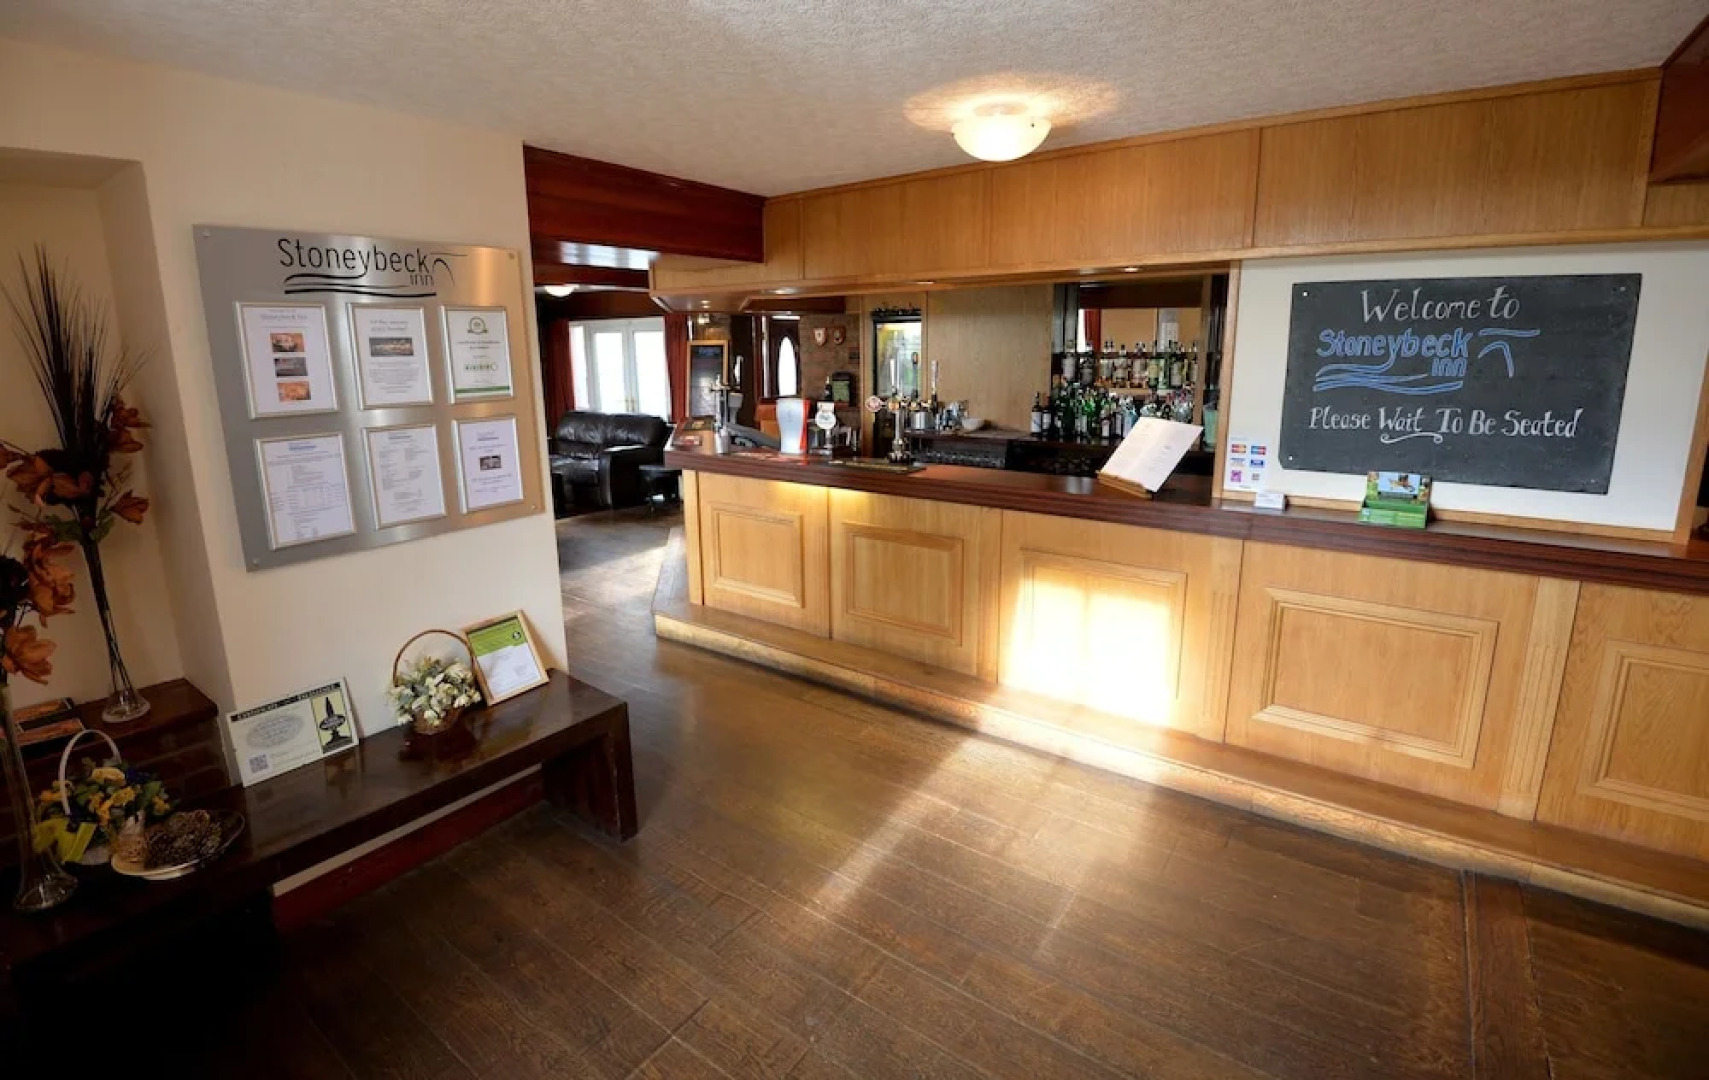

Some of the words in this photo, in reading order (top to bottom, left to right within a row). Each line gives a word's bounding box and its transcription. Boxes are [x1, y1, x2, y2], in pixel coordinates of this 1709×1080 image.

[277, 238, 430, 275] Stoneybeck
[1361, 286, 1481, 323] Welcome
[1487, 285, 1520, 319] to
[1316, 327, 1473, 361] Stoneybeck
[1308, 405, 1372, 430] Please
[1377, 406, 1425, 432] Wait
[1435, 407, 1464, 434] To
[1468, 408, 1497, 435] Be
[1501, 407, 1584, 438] Seated
